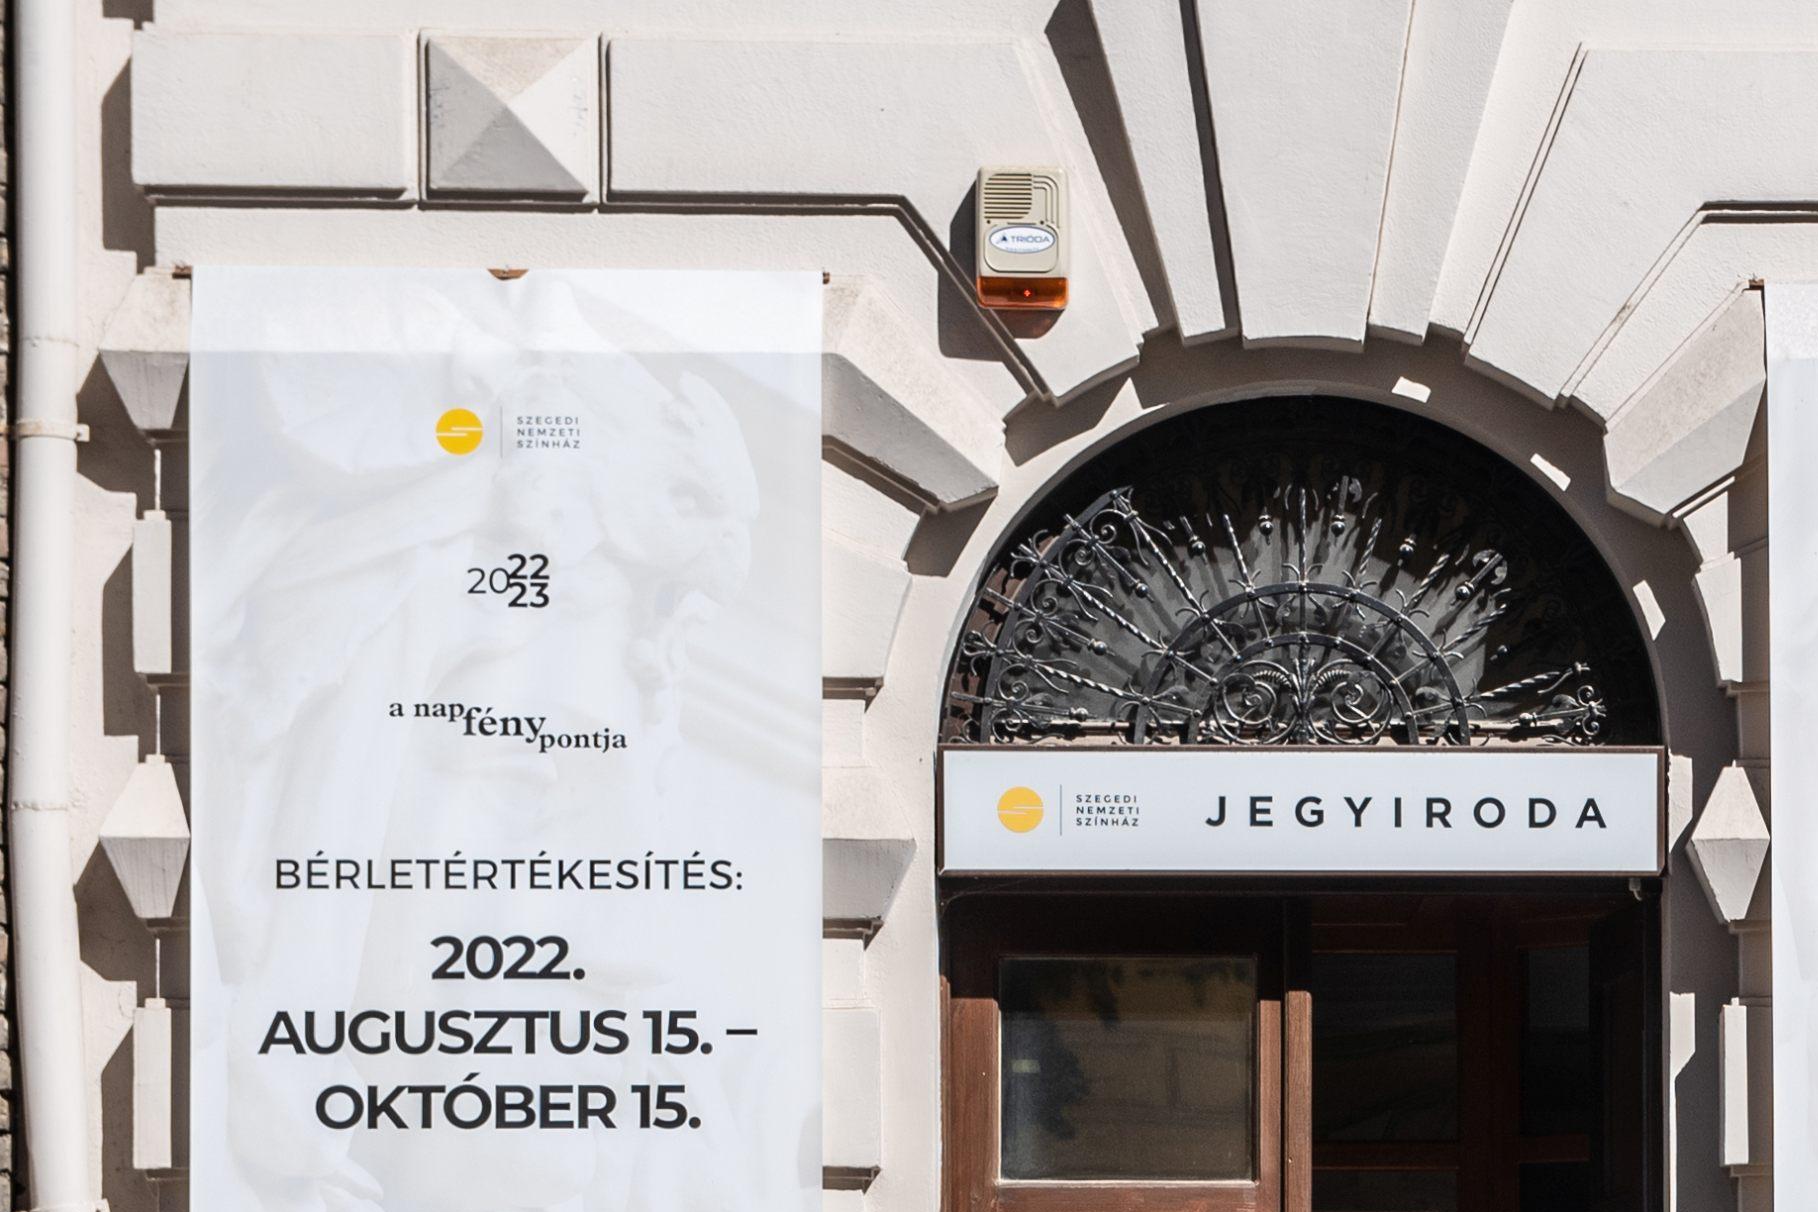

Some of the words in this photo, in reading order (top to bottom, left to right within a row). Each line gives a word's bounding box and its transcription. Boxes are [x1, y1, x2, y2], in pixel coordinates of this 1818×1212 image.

[517, 417, 579, 425] SZEGEDI
[517, 438, 580, 448] SZÍNHÁZ
[389, 701, 404, 717] a
[1076, 794, 1137, 803] SZEGEDI
[1076, 806, 1140, 814] NEMZETI
[1205, 796, 1607, 828] JEGYIRODA
[1076, 816, 1139, 826] SZÍNHÁZ
[275, 851, 743, 890] BÉRLETÉRTÉKESÍTÉS:
[431, 936, 585, 980] 2022.
[258, 1010, 628, 1054] AUGUSZTUS
[643, 1010, 712, 1054] 15.
[315, 1073, 616, 1129] OKTÓBER
[631, 1085, 700, 1129] 15.
